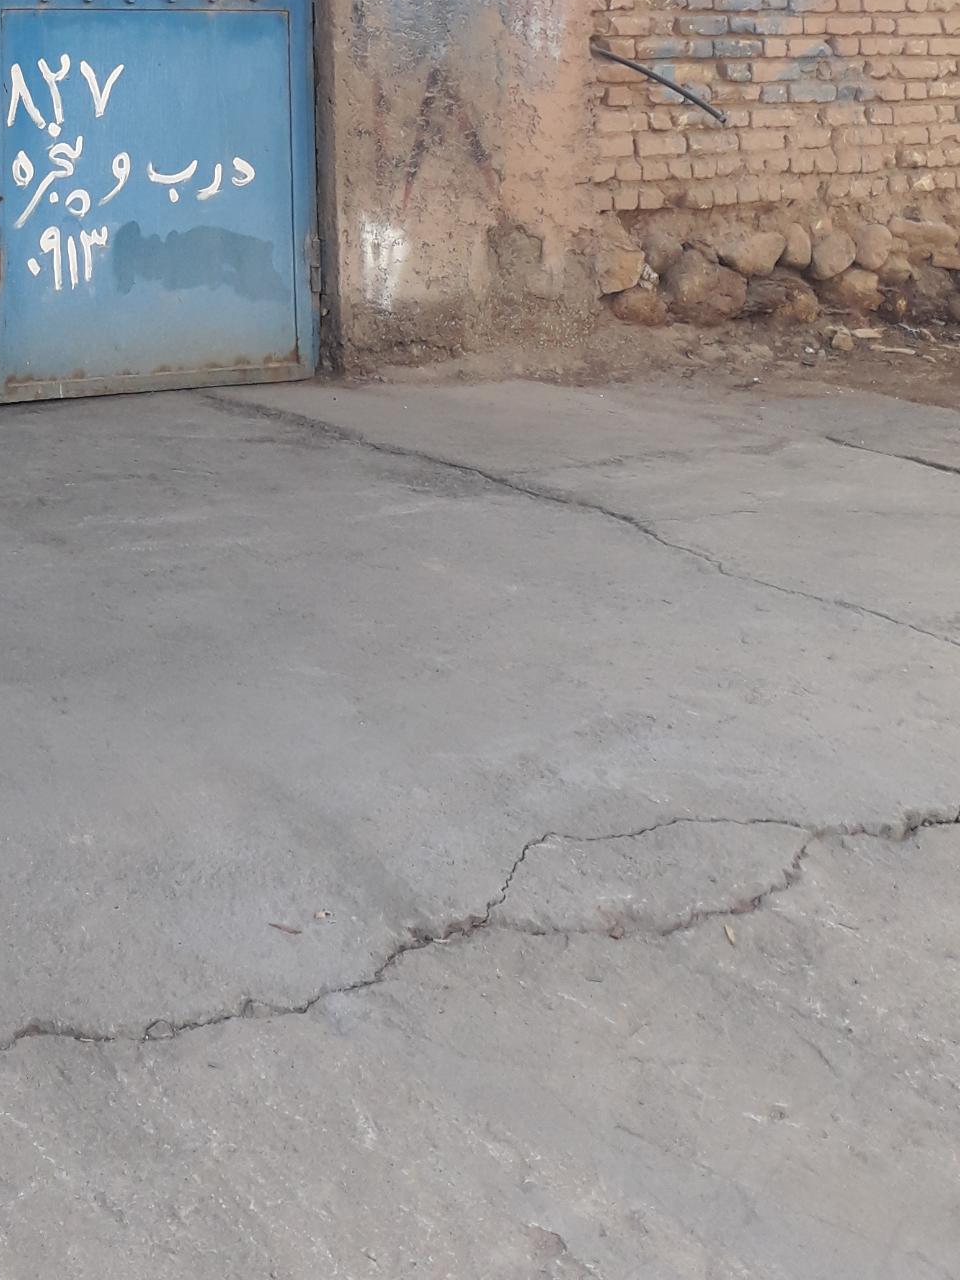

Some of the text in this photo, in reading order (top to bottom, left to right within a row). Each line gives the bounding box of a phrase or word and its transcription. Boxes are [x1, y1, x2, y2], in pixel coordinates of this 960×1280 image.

[7, 53, 124, 129] ۸۲۷
[99, 151, 130, 206] و
[147, 156, 256, 203] درب
